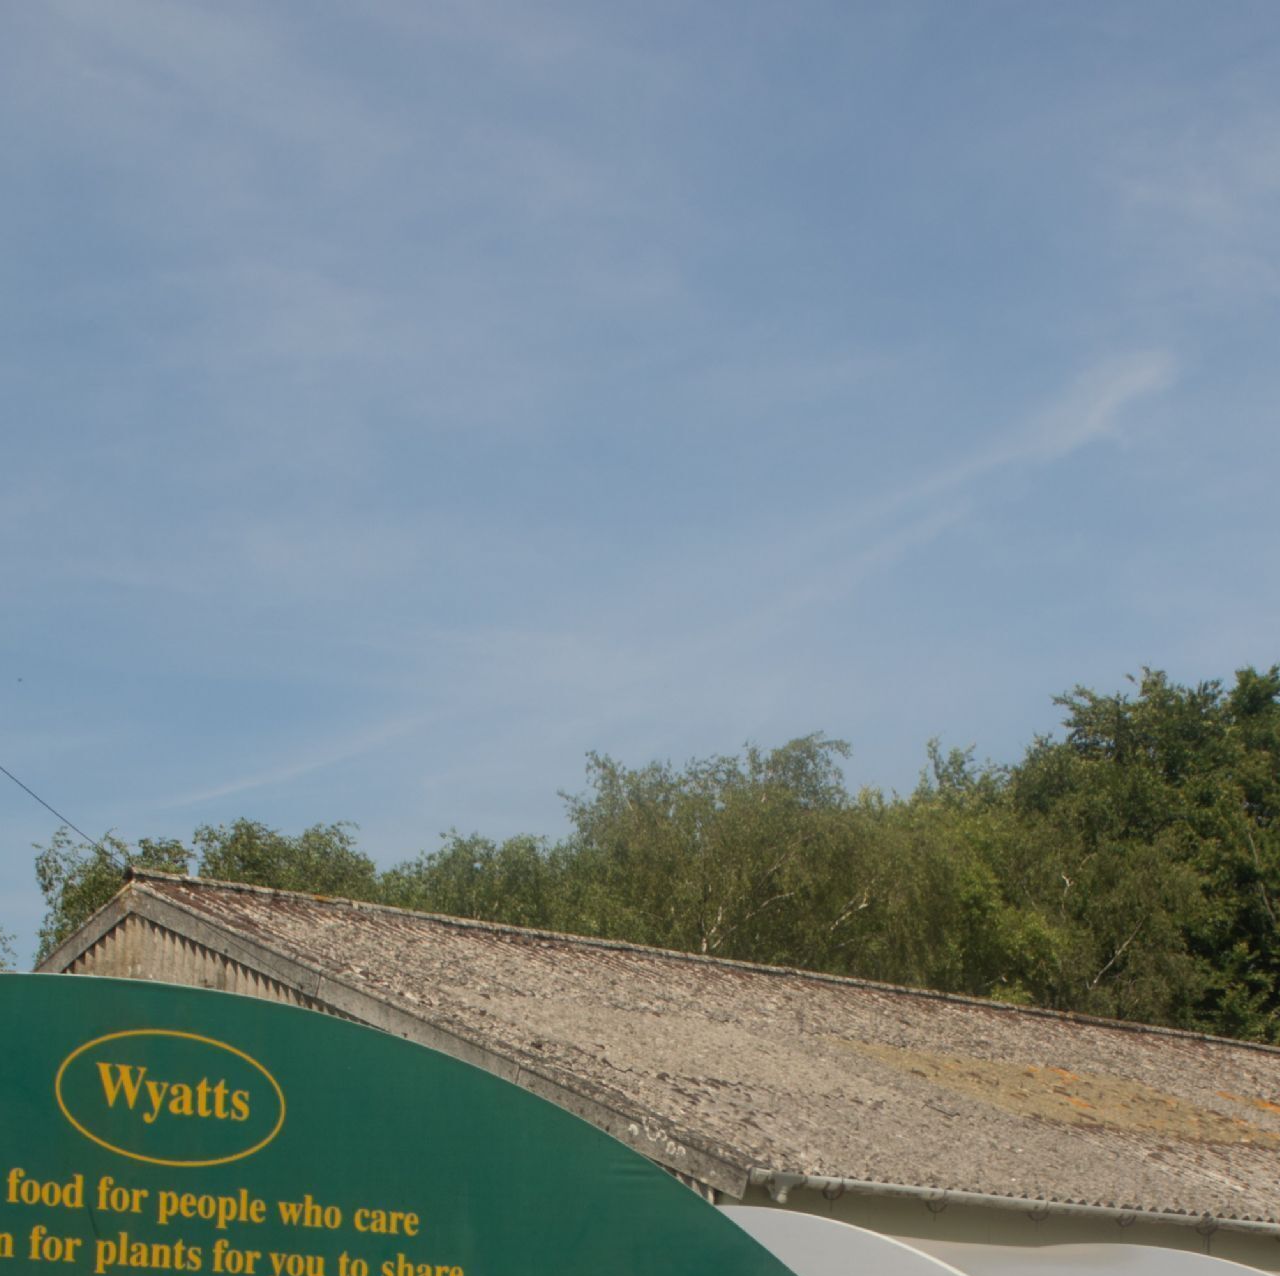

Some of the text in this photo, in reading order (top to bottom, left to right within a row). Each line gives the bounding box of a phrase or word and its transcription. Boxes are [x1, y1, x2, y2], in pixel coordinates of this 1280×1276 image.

[96, 1061, 250, 1124] Wyatts
[7, 1167, 85, 1209] food
[96, 1175, 149, 1214] for
[158, 1188, 267, 1230] people
[277, 1194, 343, 1230] who
[353, 1208, 420, 1237] care
[29, 1224, 83, 1263] for
[95, 1231, 202, 1274] plants
[212, 1238, 262, 1275] for
